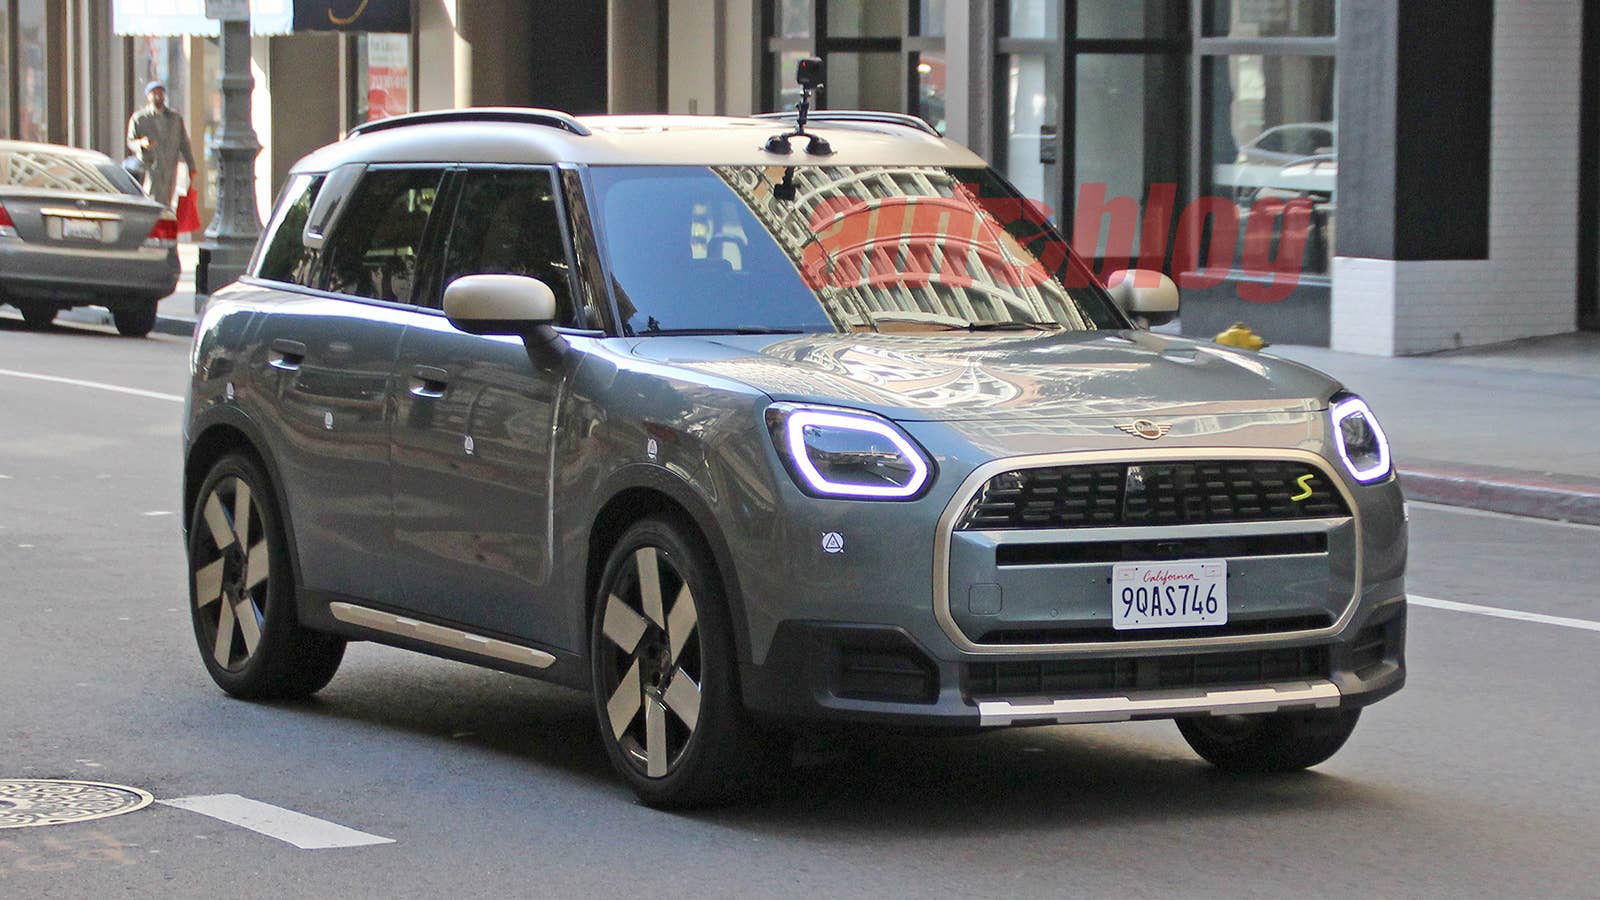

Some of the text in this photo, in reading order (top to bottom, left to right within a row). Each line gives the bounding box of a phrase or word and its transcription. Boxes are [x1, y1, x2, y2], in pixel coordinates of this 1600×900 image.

[1290, 473, 1314, 502] S
[1143, 570, 1200, 585] California
[1121, 583, 1218, 618] 9QAS746
